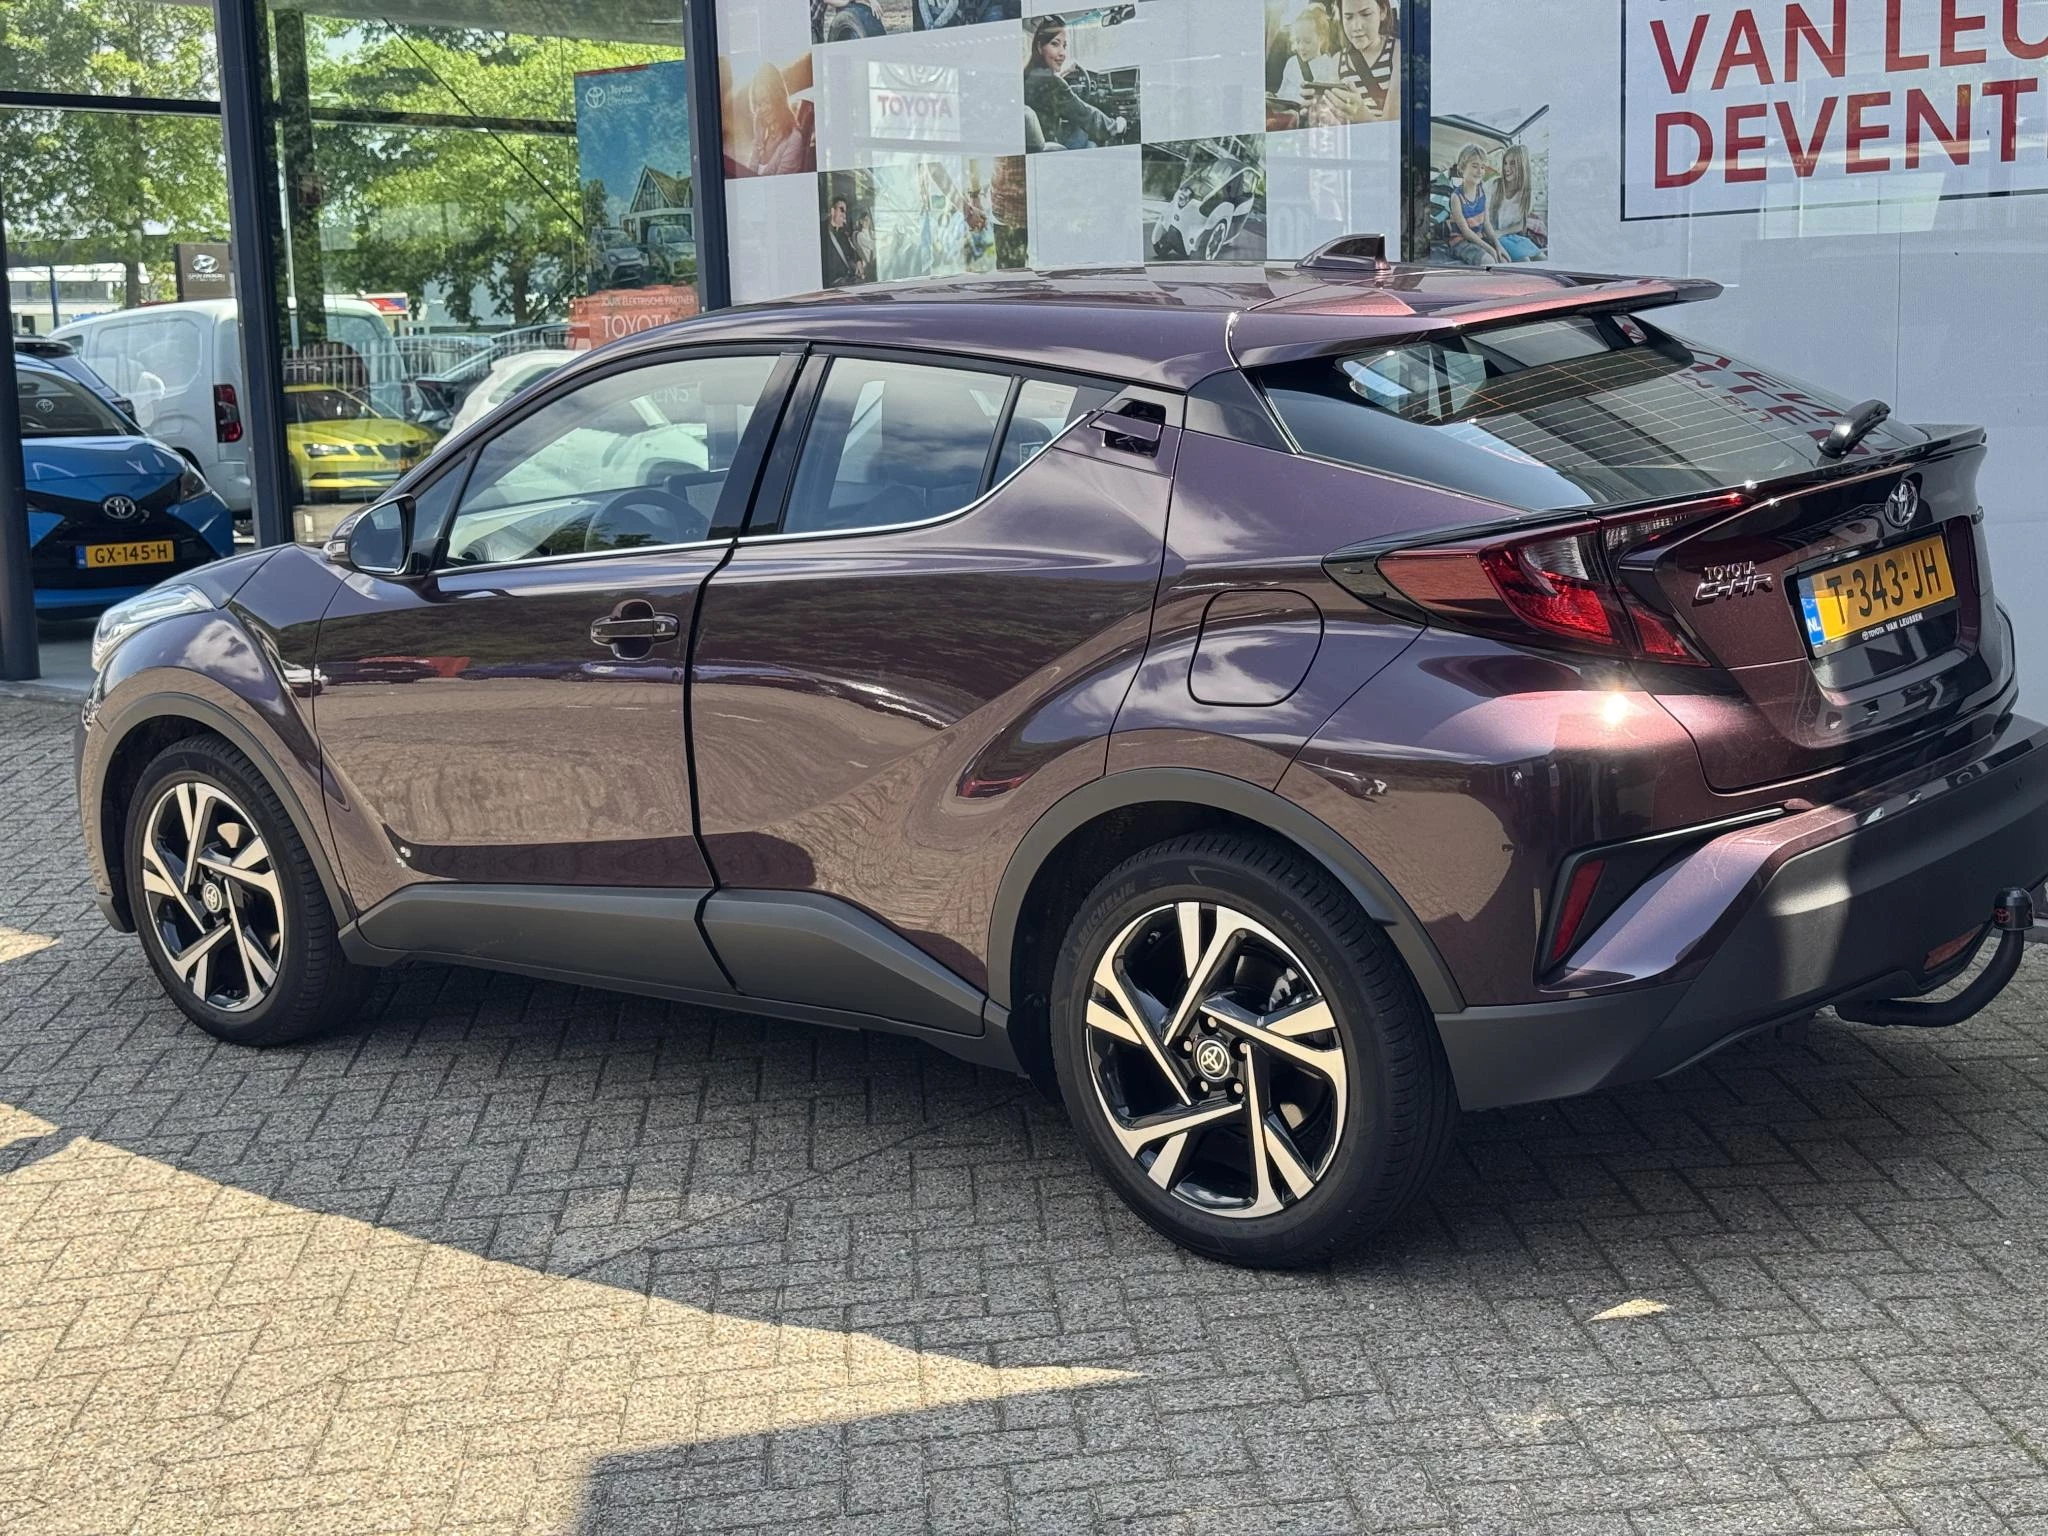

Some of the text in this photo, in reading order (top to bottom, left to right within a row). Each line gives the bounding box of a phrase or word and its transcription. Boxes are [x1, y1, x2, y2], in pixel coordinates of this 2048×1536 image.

[1649, 0, 2048, 94] VAN LEU
[877, 95, 952, 118] TOYOTA
[1655, 77, 2048, 190] DEVENT
[94, 543, 168, 564] GX-145-H
[1704, 560, 1757, 581] TOYOTA
[1826, 547, 1942, 625] T-343-JH
[1806, 618, 1821, 632] NL
[1885, 620, 1899, 632] VAN
[1899, 611, 1923, 627] LEUSSEN
[1078, 880, 1136, 945] MICHELIN
